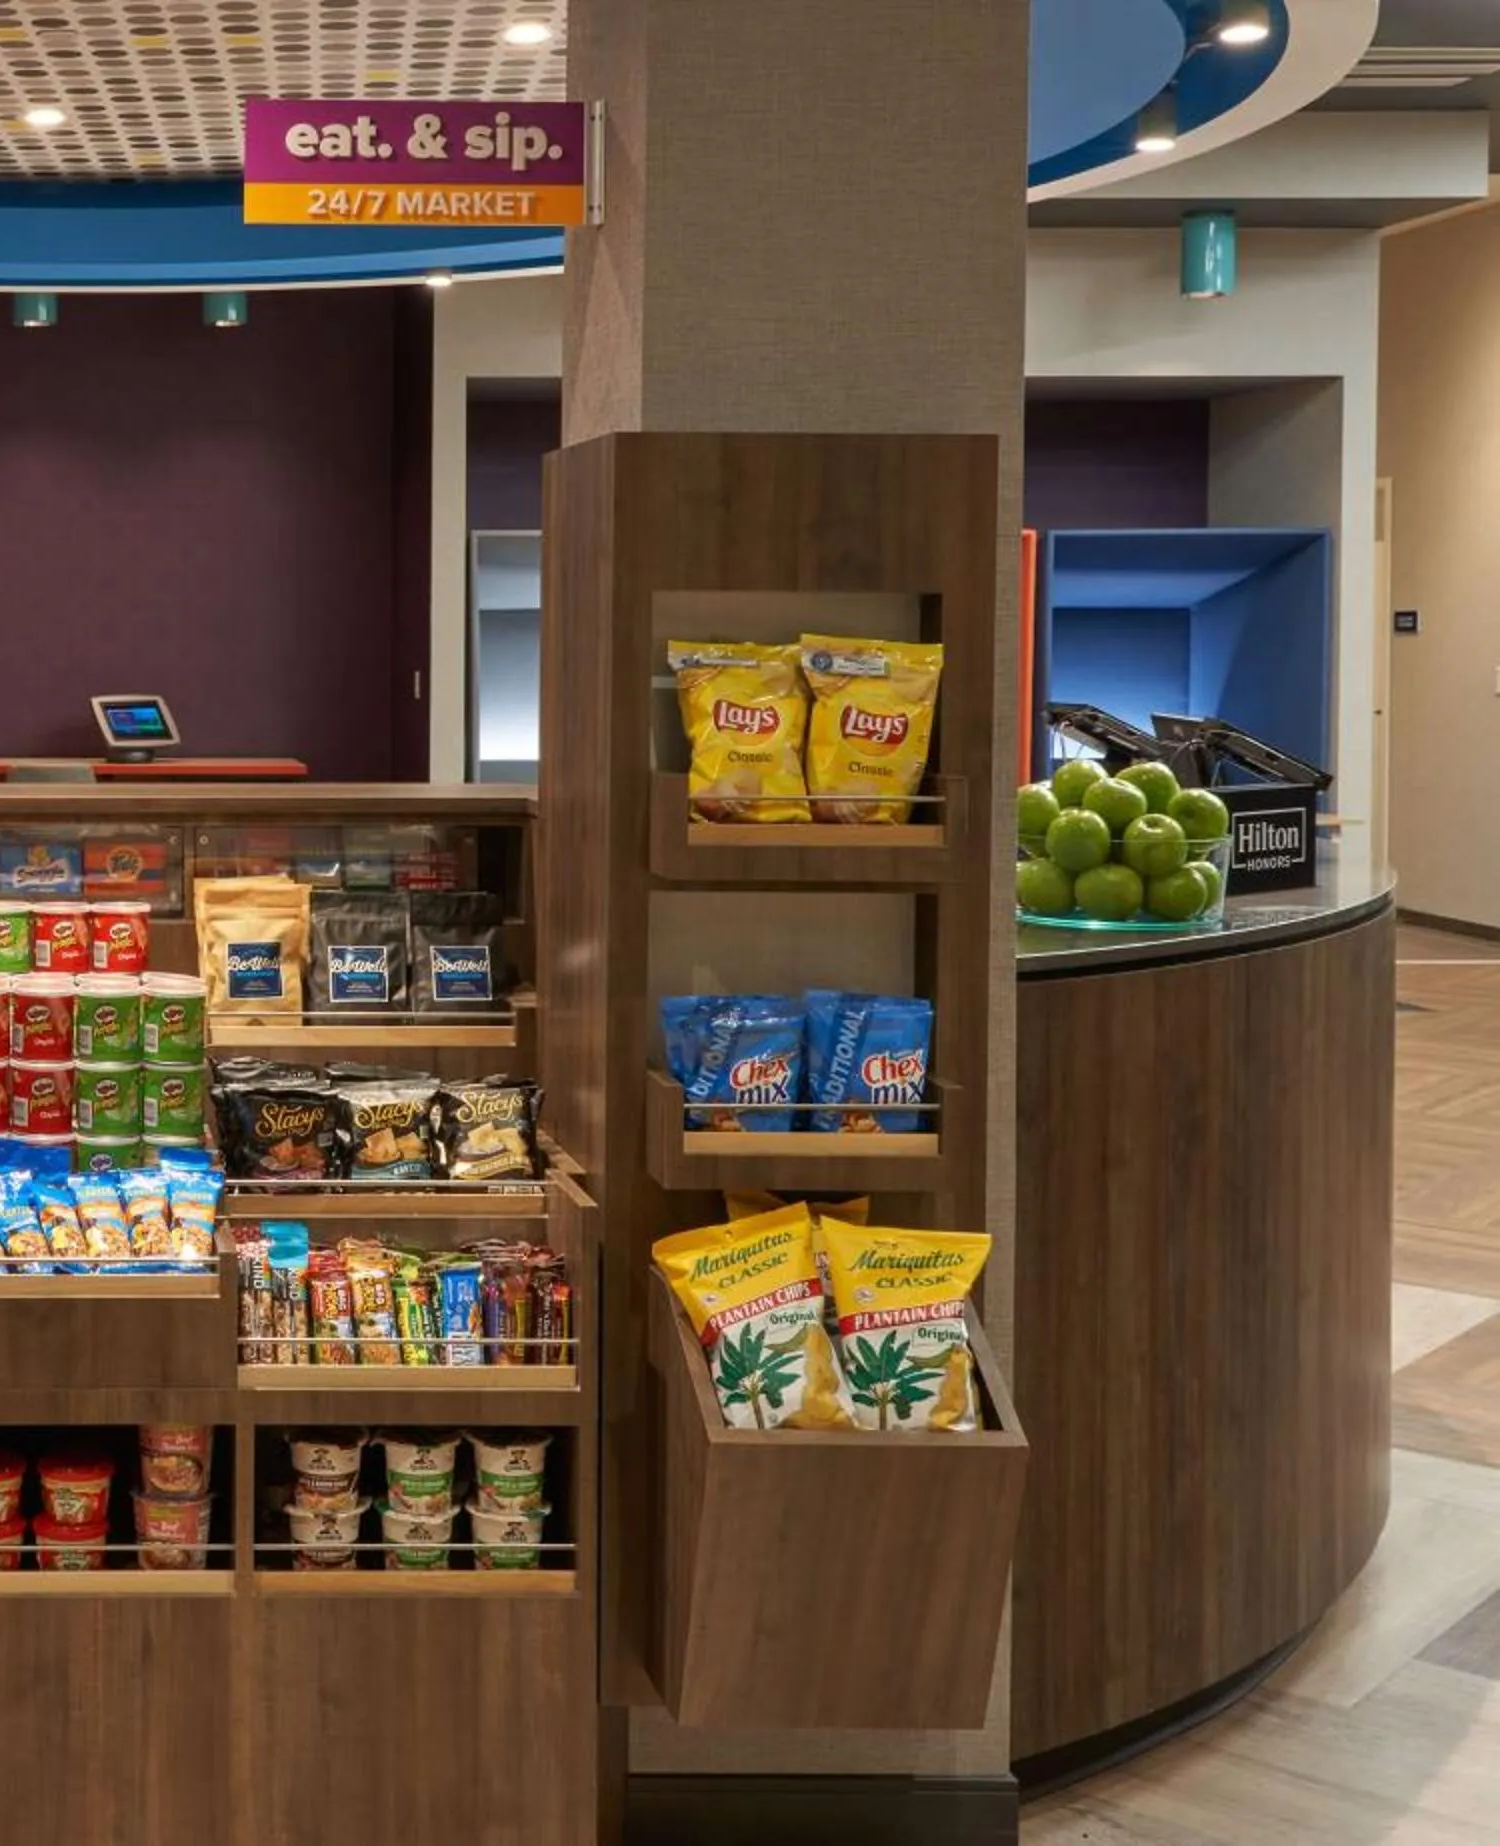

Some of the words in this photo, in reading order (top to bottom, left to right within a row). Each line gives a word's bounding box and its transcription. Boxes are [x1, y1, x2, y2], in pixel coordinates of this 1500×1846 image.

[284, 115, 393, 159] eat.
[406, 113, 449, 160] &
[464, 111, 563, 171] sip.
[307, 189, 386, 218] 24/7
[396, 191, 535, 217] MARKET
[727, 750, 773, 764] Classic
[848, 761, 895, 777] Classic
[1238, 823, 1300, 853] Hilton
[1247, 855, 1291, 871] HONORS
[730, 1057, 790, 1089] Chex
[862, 1054, 926, 1085] Chex
[689, 1230, 794, 1283] Mariquitas
[719, 1252, 789, 1290] CLASSIC
[850, 1249, 965, 1272] Mariquitas
[875, 1272, 954, 1289] CLASSIC
[709, 1294, 775, 1331] PLANTAIN
[775, 1280, 812, 1305] CHIPS
[853, 1307, 928, 1330] PLANTAIN
[930, 1301, 965, 1319] CHIP
